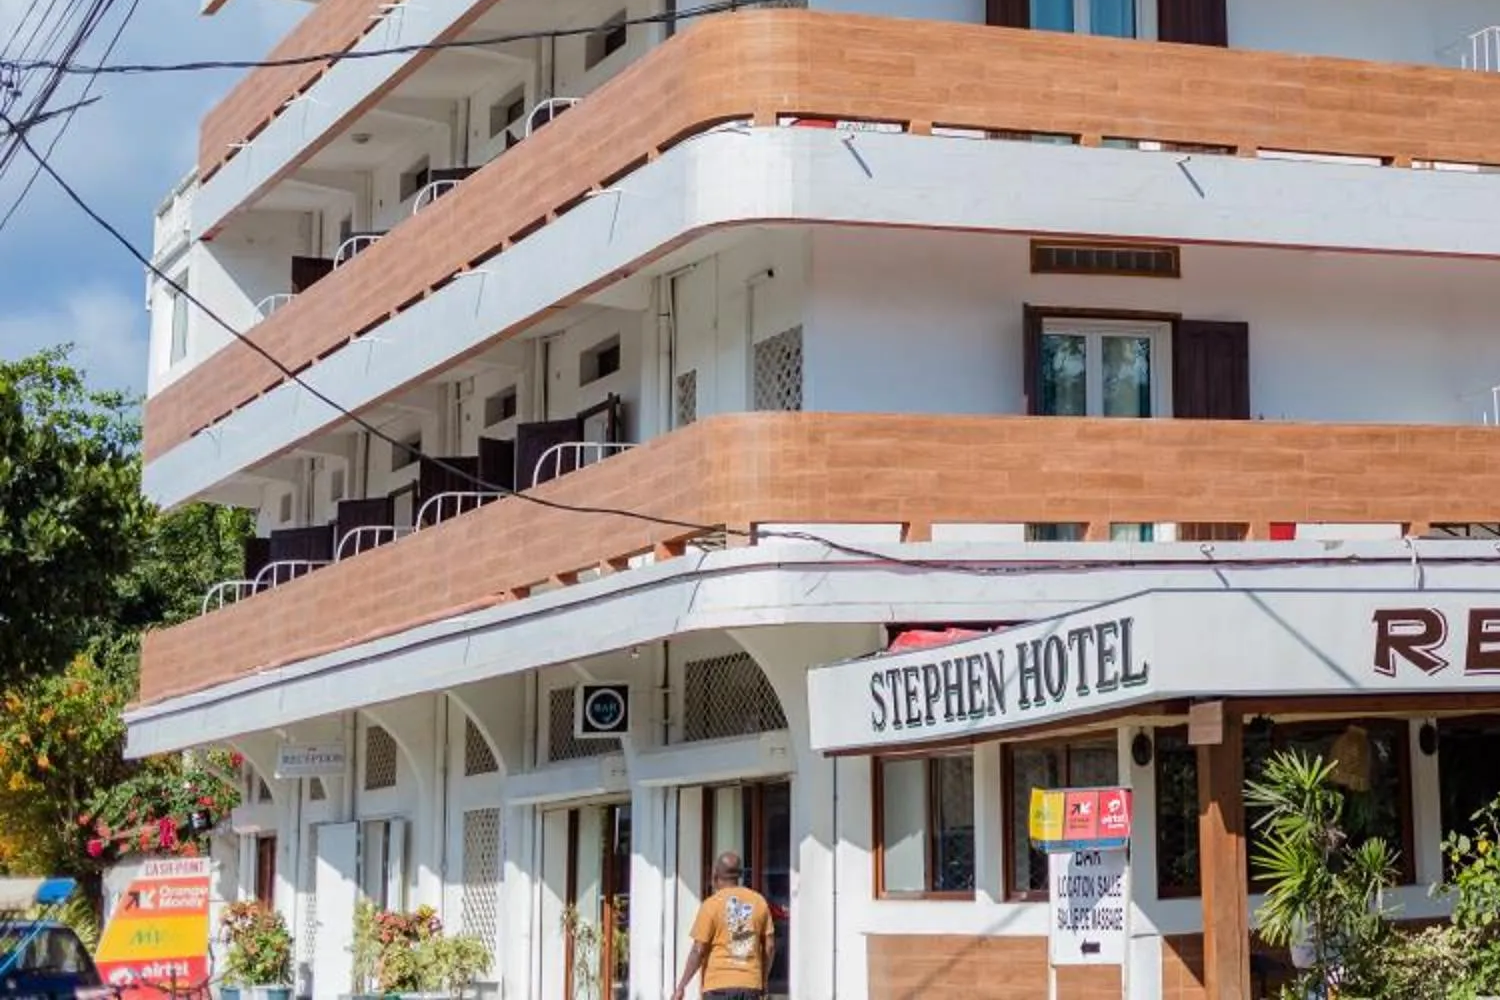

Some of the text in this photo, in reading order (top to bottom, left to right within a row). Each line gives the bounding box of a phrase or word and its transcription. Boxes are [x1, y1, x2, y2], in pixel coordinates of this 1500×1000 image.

[870, 616, 1149, 732] STEPHEN HOTEL
[1057, 875, 1095, 897] LOCATION
[141, 961, 190, 979] airtel
